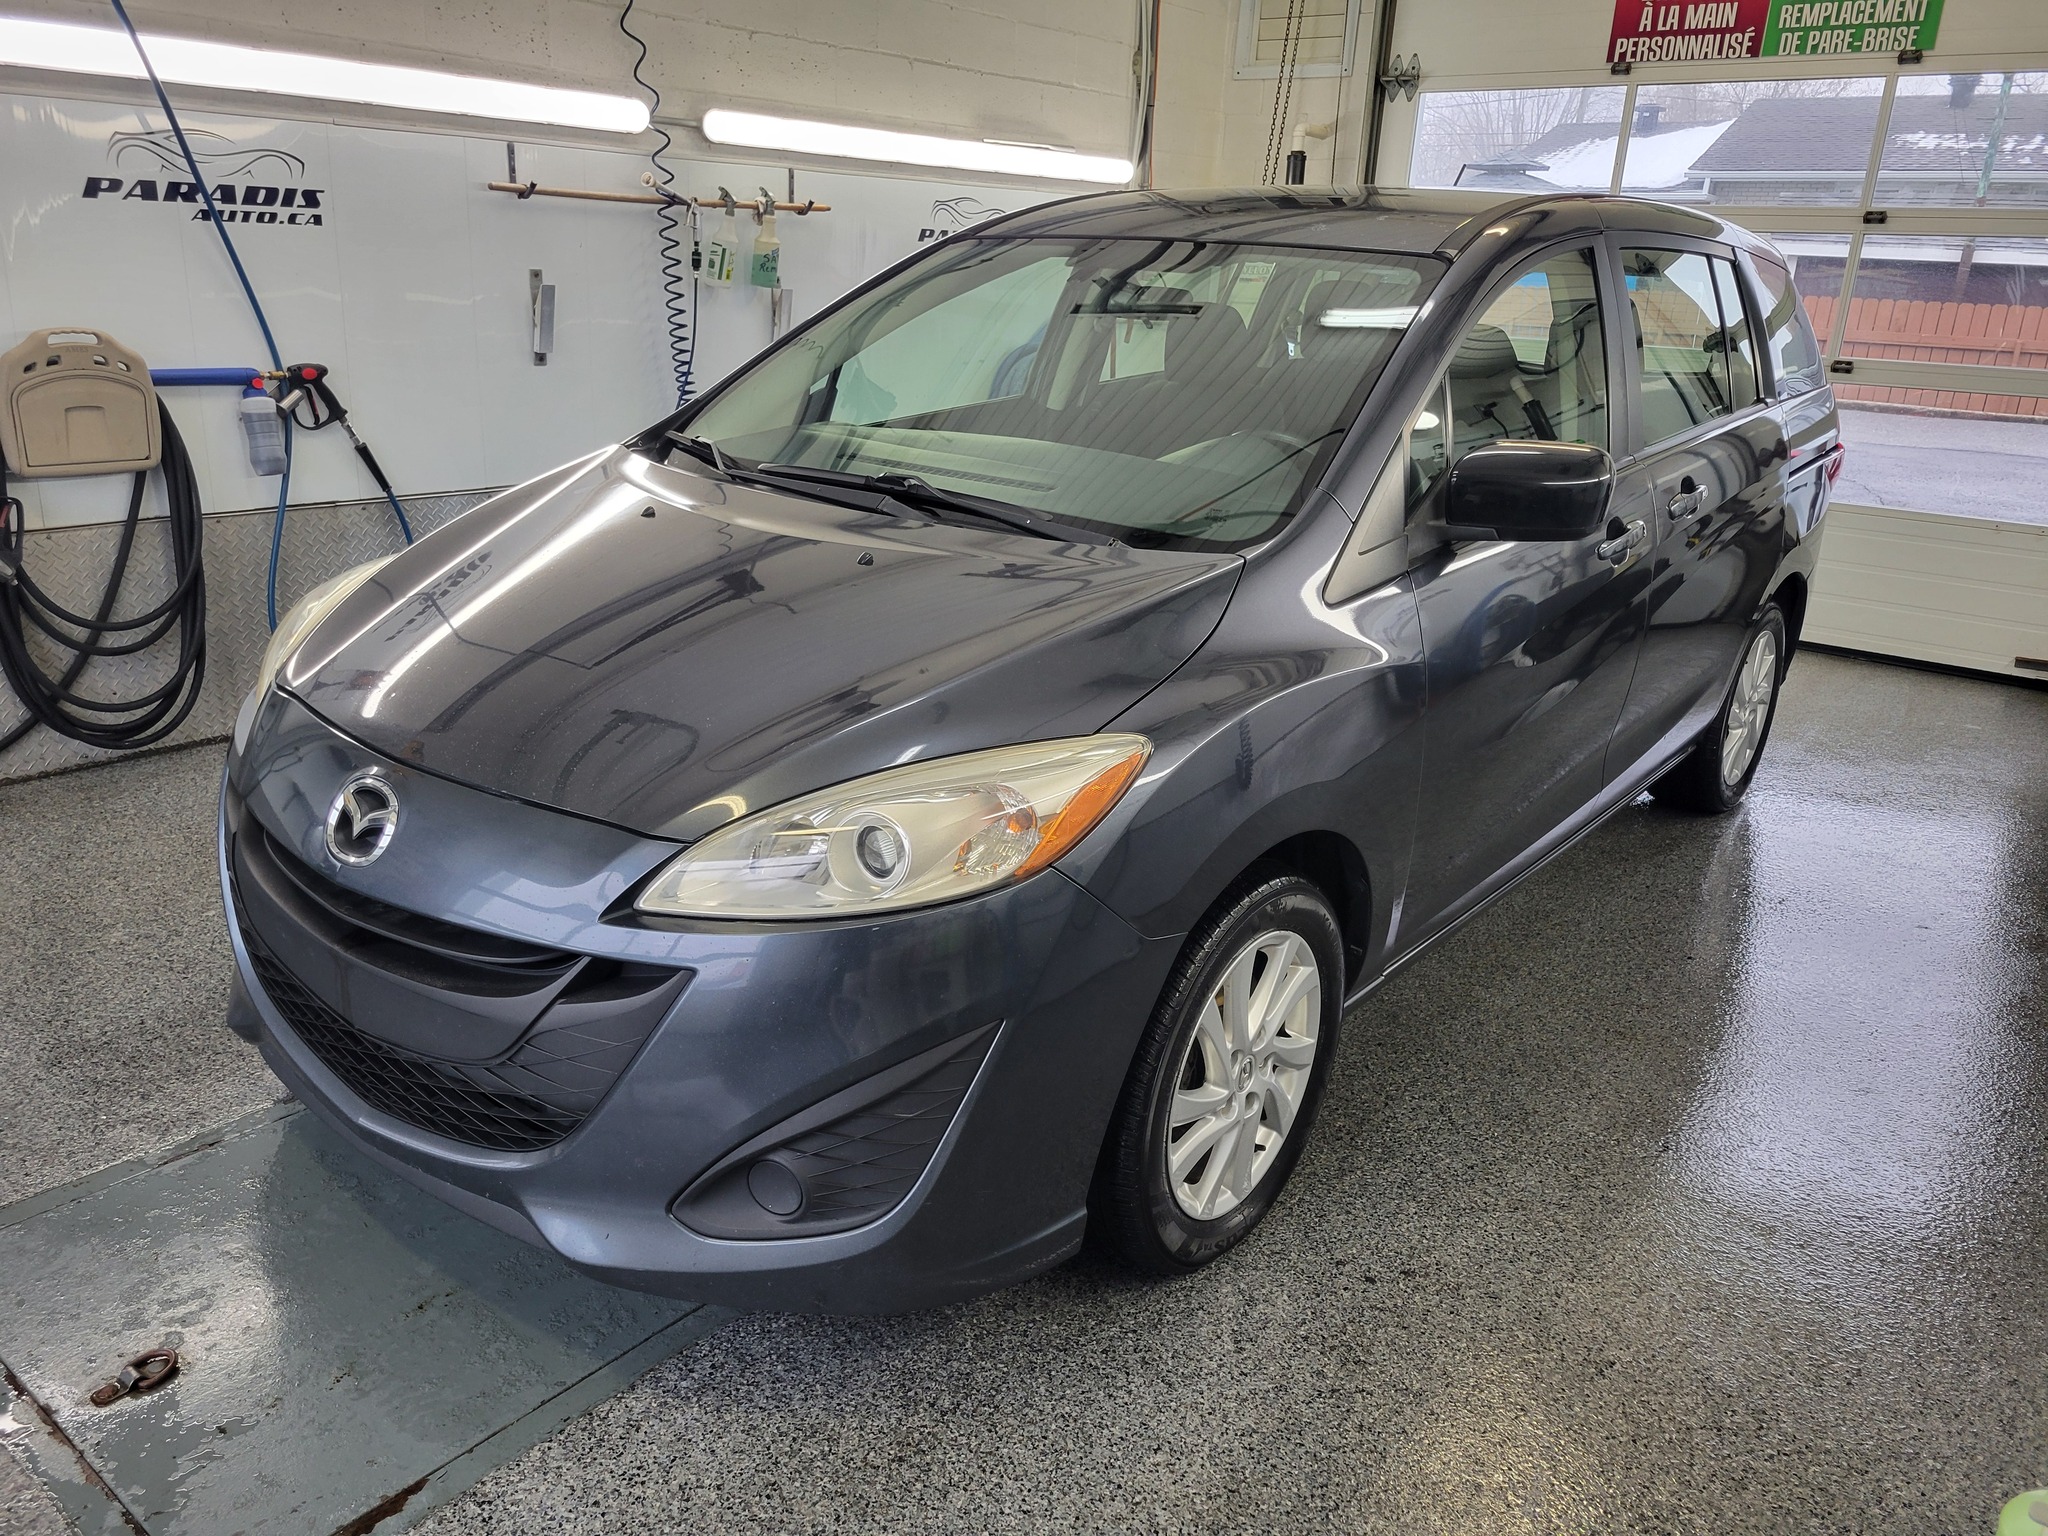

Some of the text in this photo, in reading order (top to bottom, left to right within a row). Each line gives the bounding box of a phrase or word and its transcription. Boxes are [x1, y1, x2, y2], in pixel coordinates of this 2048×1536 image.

[1638, 1, 1739, 32] À LA MAIN
[1778, 0, 1929, 28] REMPLACEMENT
[1613, 26, 1756, 62] PERSONNALISÉ
[1778, 26, 1921, 56] DE PARE-BRISE
[82, 177, 325, 209] PARADIS
[191, 209, 323, 226] AUTO.CA
